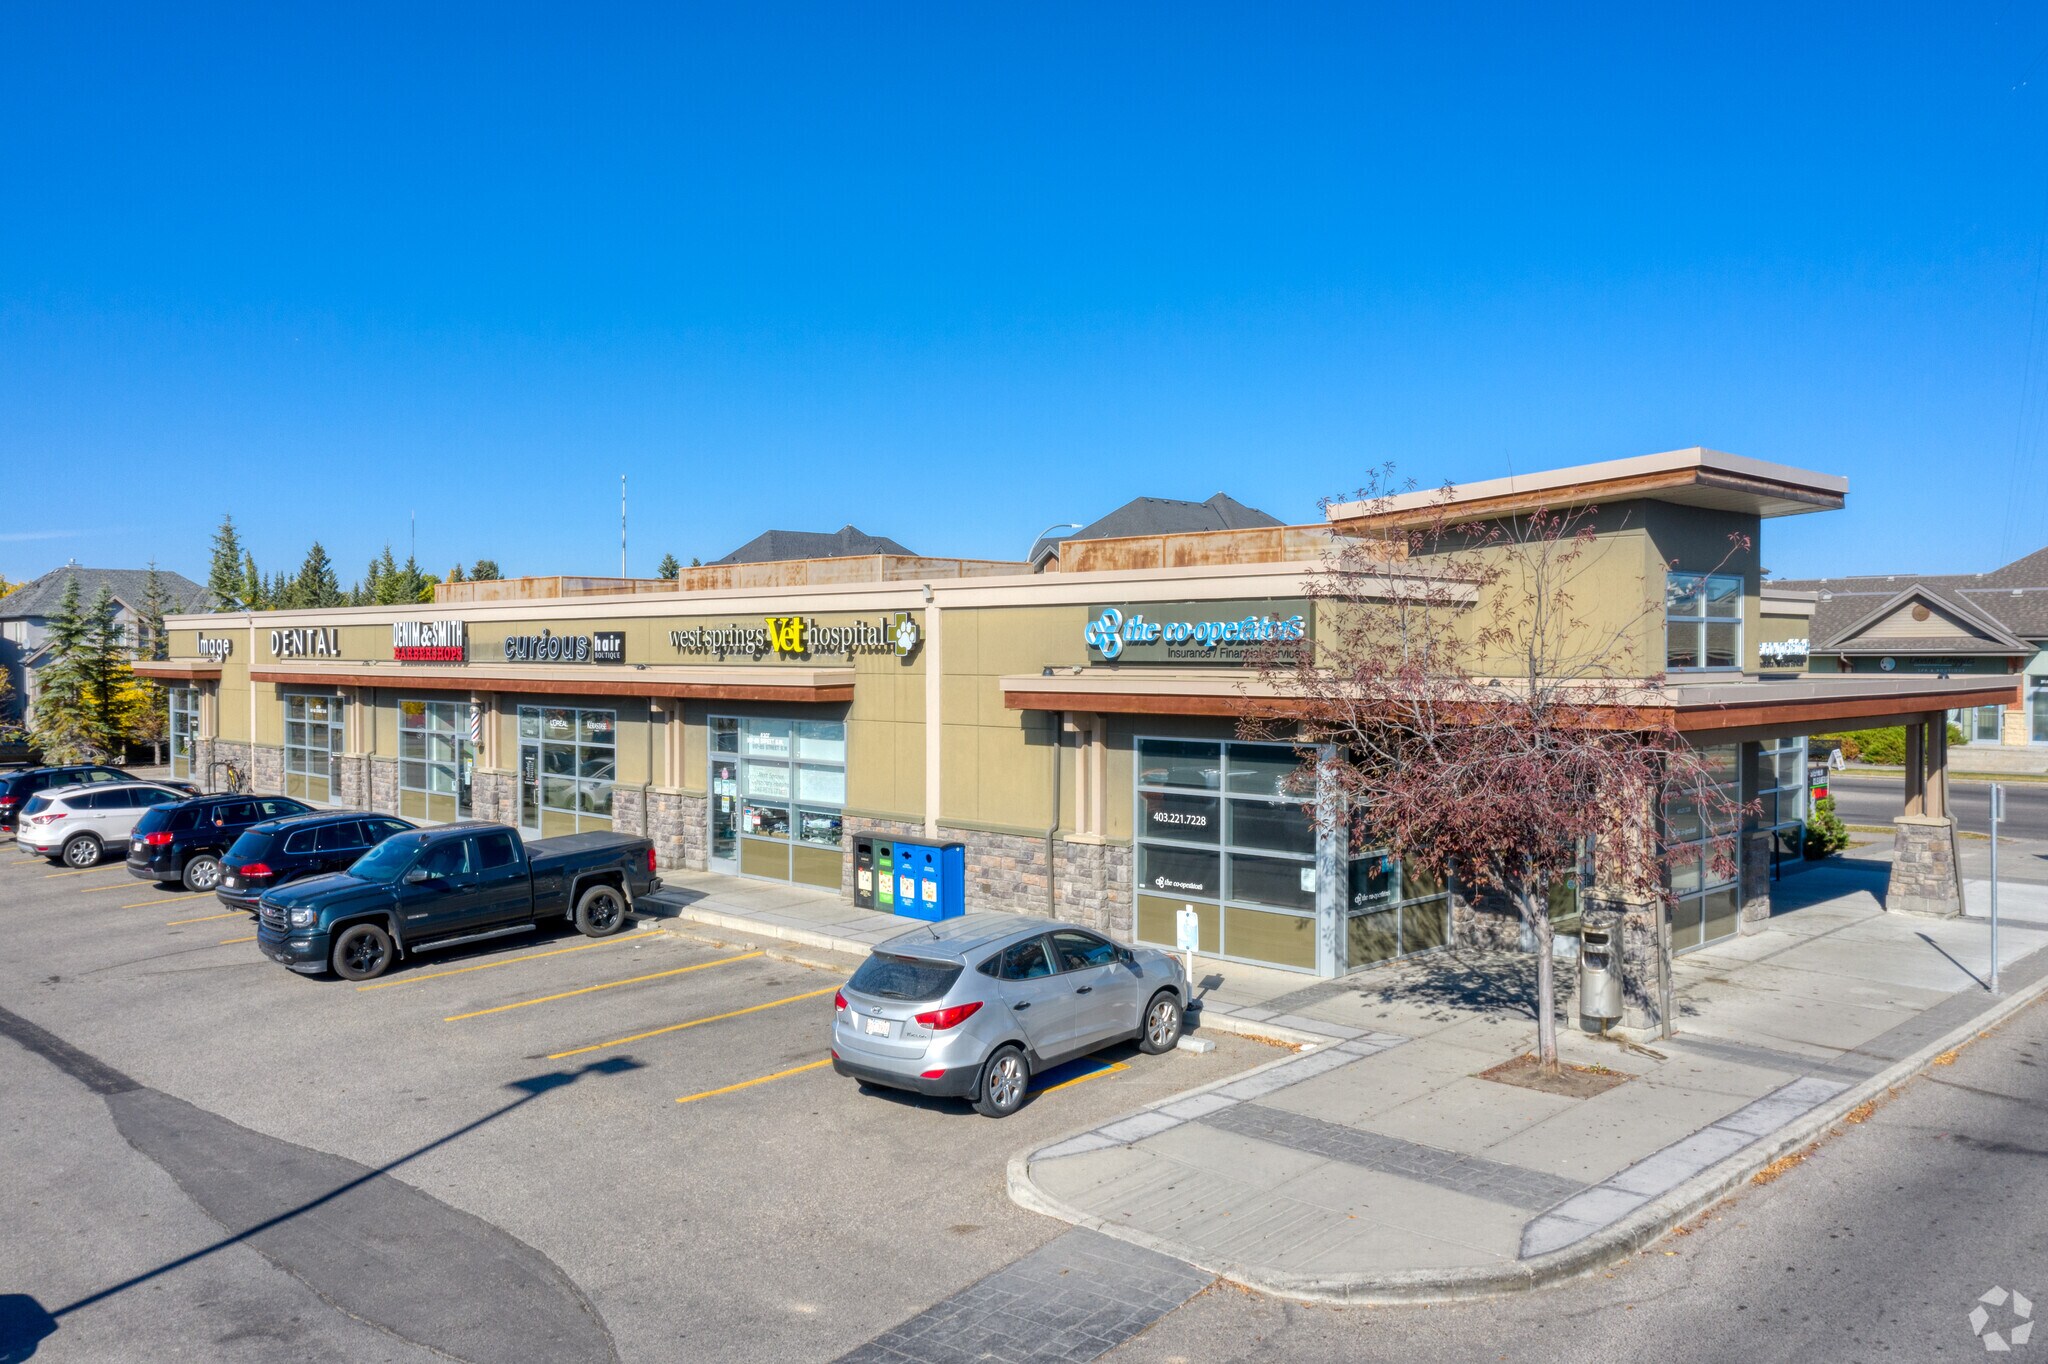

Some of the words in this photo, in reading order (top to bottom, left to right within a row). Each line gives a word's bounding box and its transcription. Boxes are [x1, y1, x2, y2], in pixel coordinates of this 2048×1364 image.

[668, 626, 702, 647] west
[704, 623, 764, 654] springs
[765, 616, 805, 653] Vet
[807, 618, 885, 652] hospital
[1123, 614, 1160, 641] the
[196, 631, 230, 660] Image
[270, 628, 337, 655] DENTAL
[594, 634, 621, 651] hair
[393, 645, 463, 661] BARBERSHOPS
[1167, 647, 1211, 659] Insurance
[1153, 811, 1207, 826] 403.221.7228
